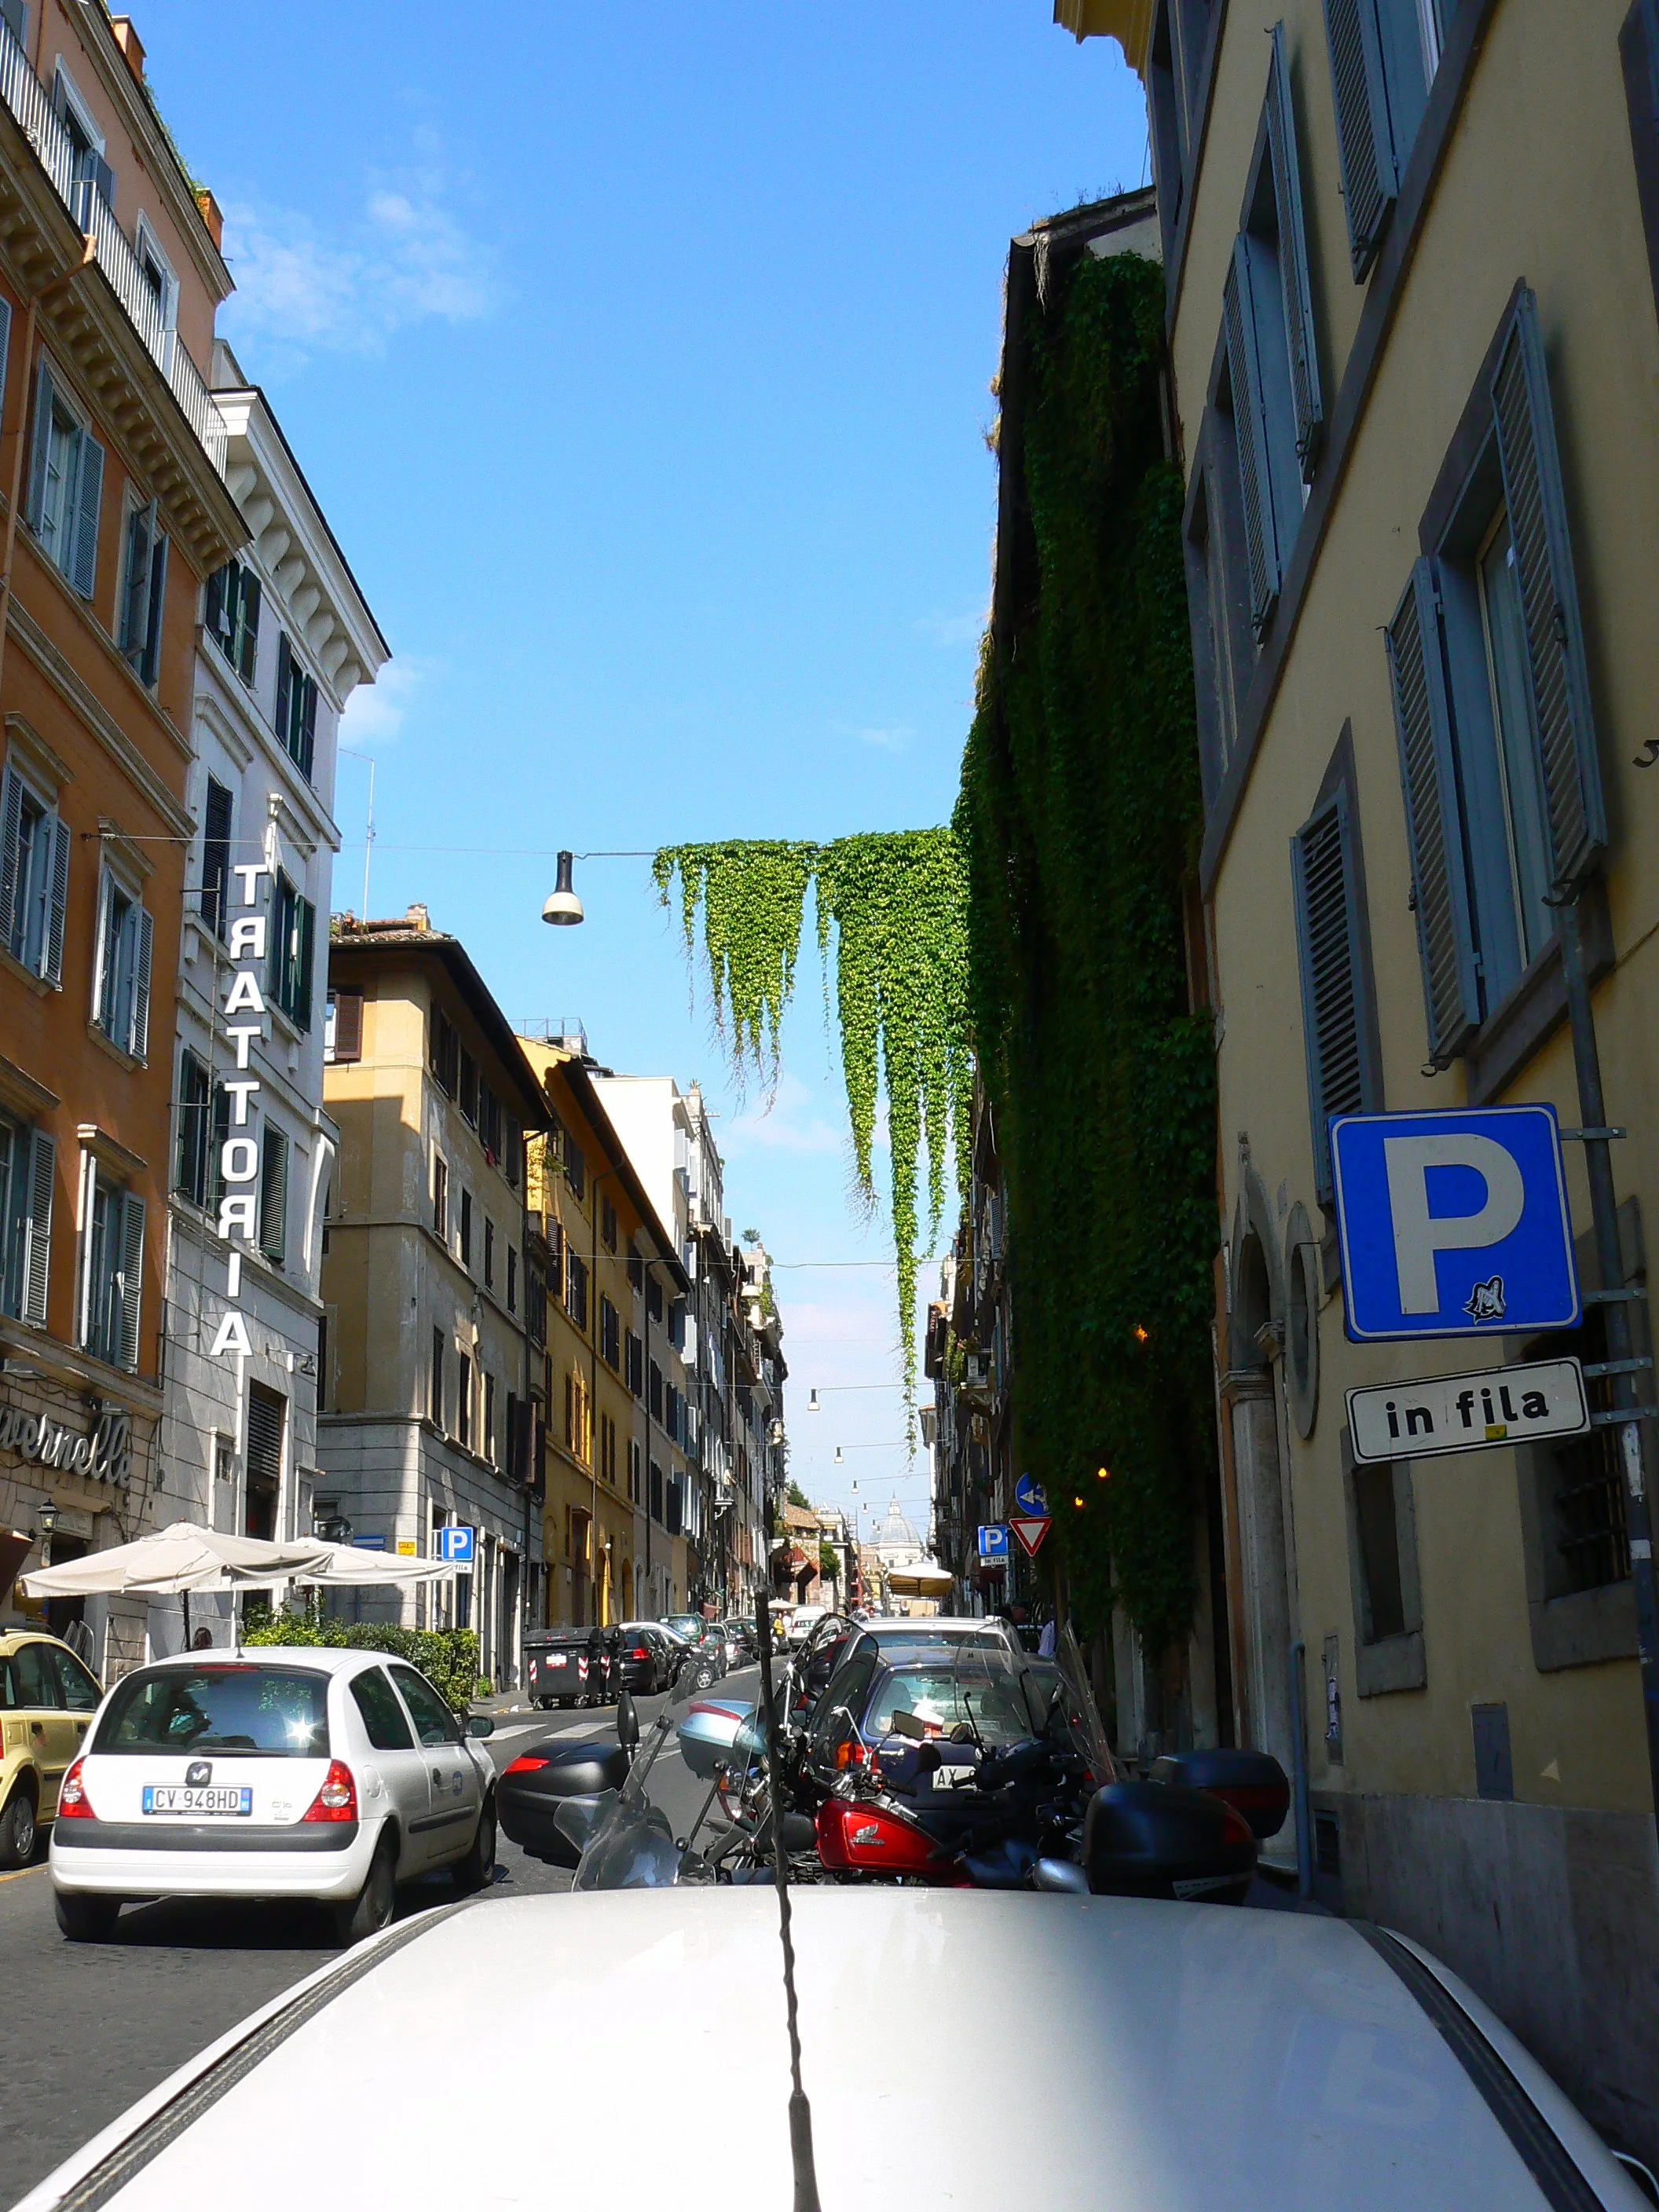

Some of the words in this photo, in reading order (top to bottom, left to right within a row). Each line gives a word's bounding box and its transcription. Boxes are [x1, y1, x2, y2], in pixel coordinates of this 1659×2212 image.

[1383, 1133, 1525, 1315] P
[1385, 1401, 1434, 1438] in
[1456, 1385, 1550, 1428] fila
[0, 1407, 133, 1489] vernelle
[449, 1531, 467, 1557] P
[985, 1529, 1002, 1552] P
[936, 1767, 958, 1785] AX
[156, 1789, 177, 1808] CV
[184, 1789, 239, 1809] 948HD
